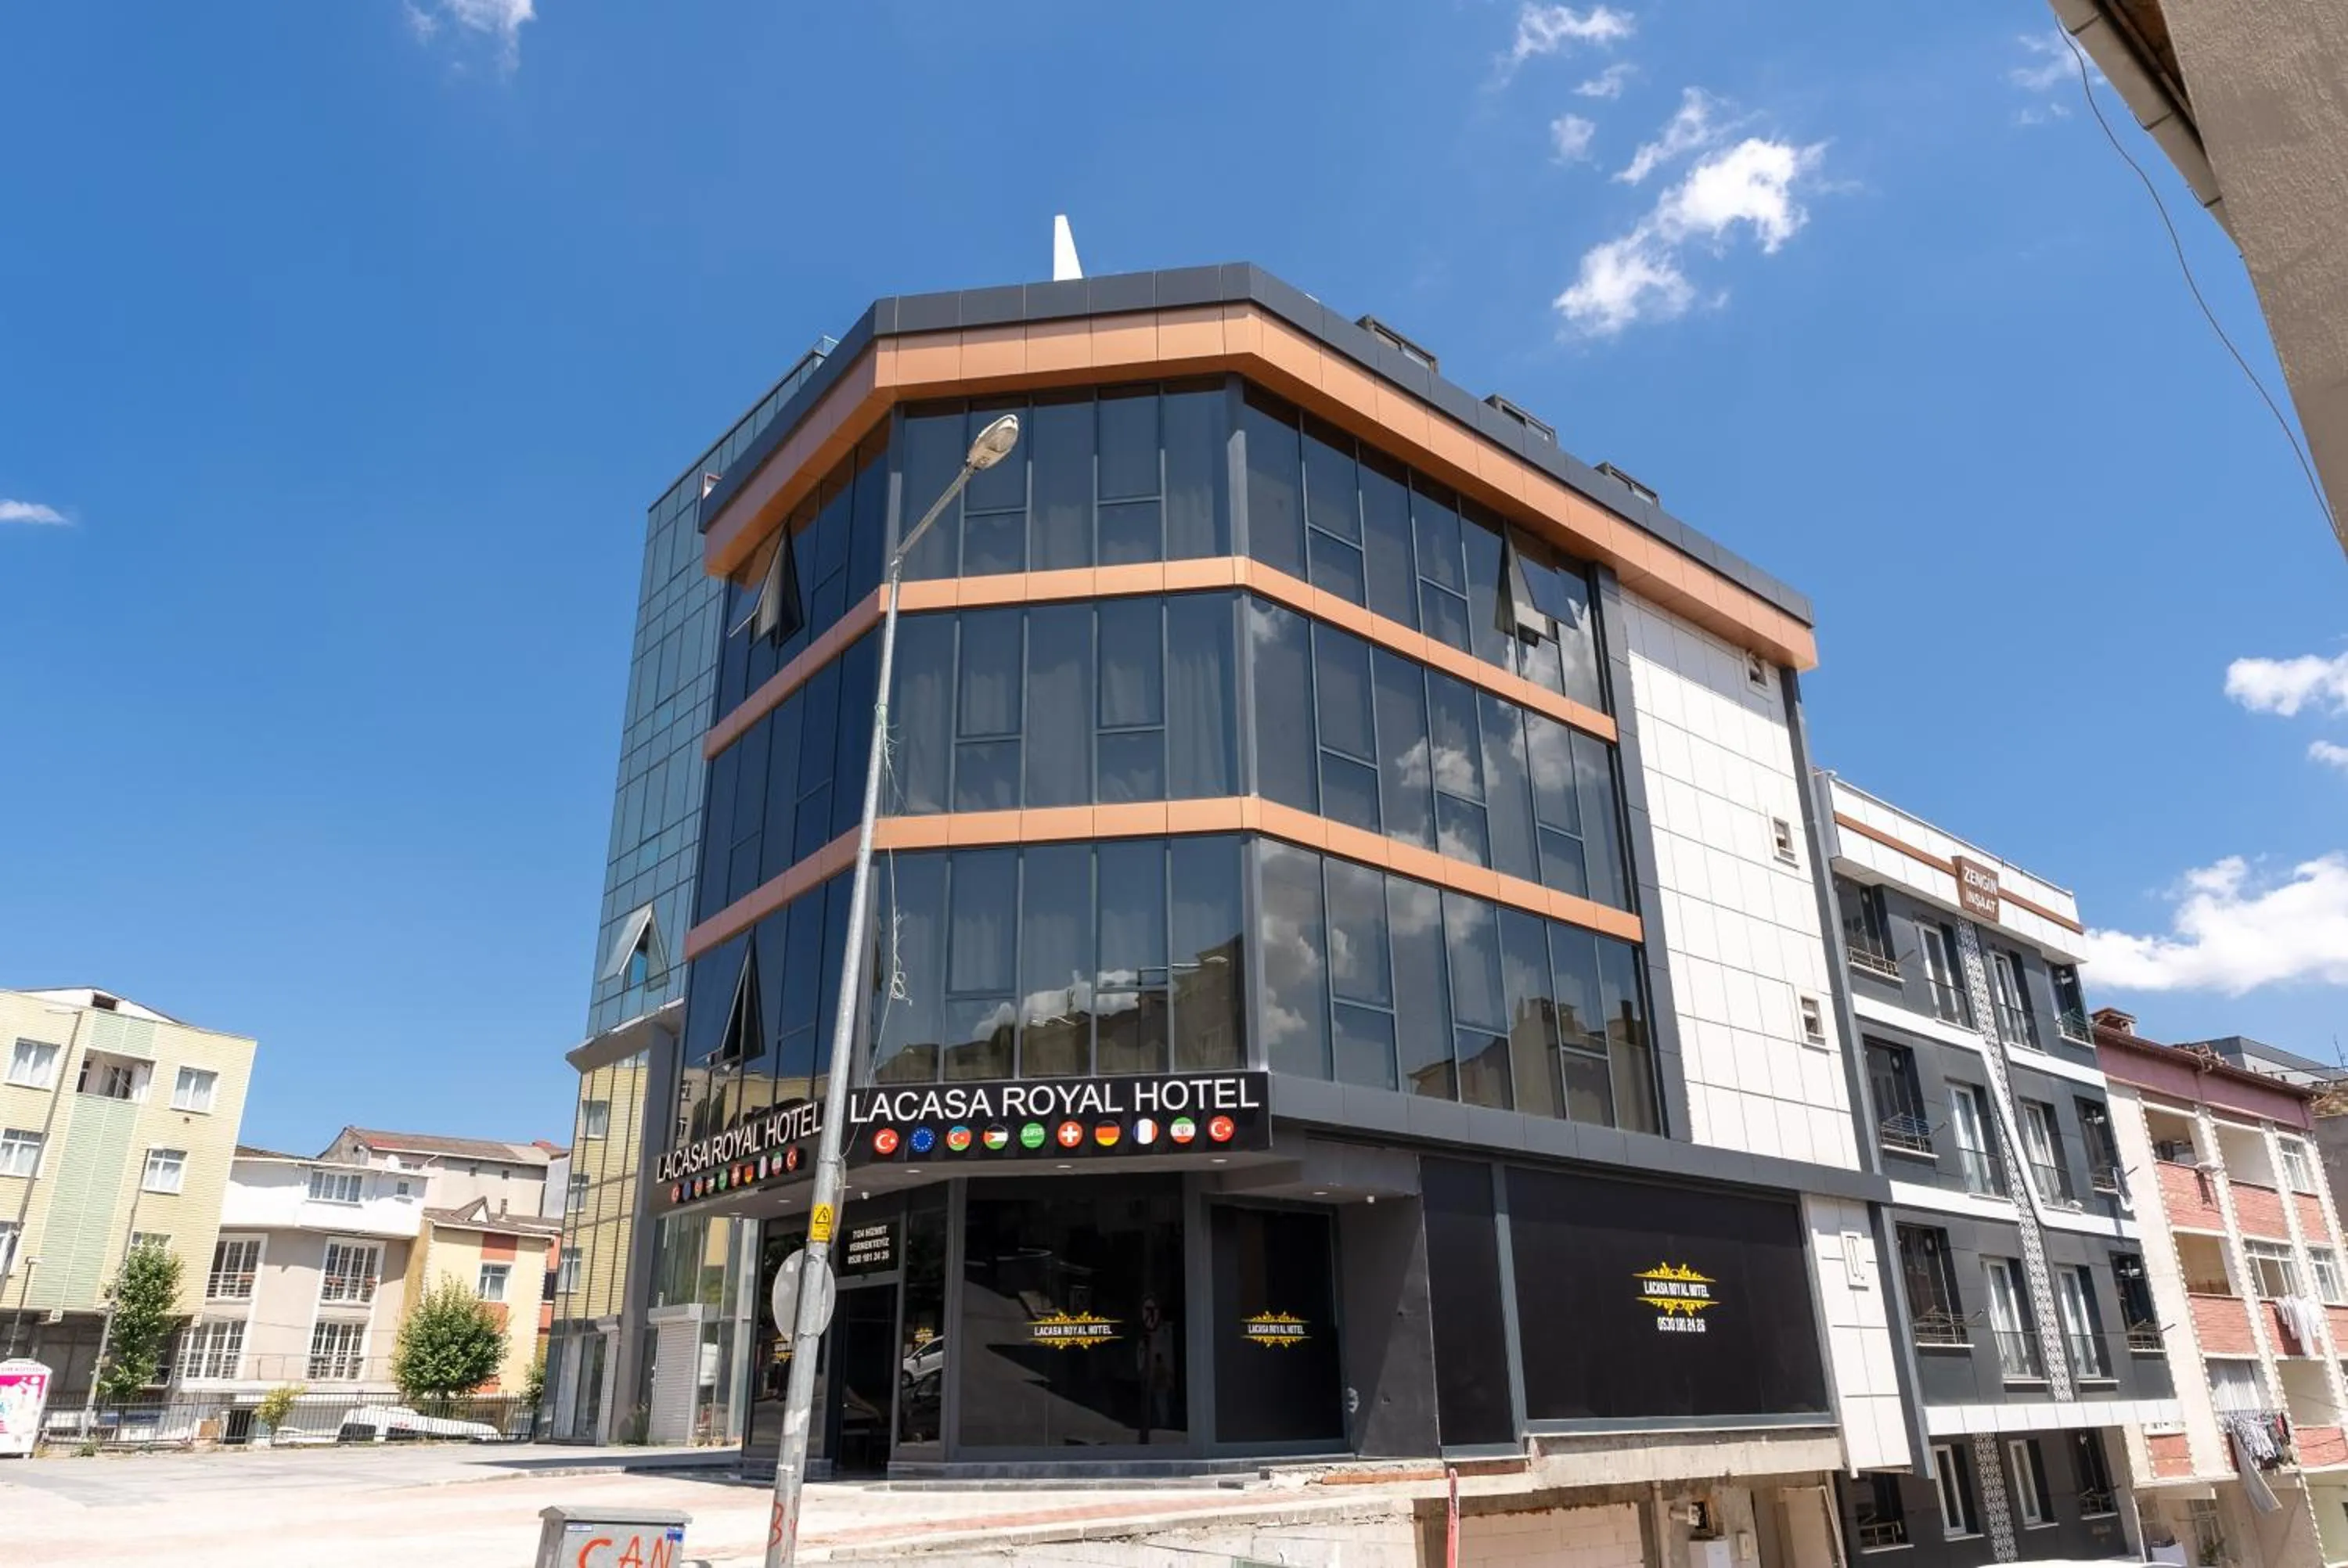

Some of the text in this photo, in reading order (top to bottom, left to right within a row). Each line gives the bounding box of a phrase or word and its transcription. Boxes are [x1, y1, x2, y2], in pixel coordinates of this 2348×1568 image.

[850, 1077, 1259, 1124] LACASA ROYAL HOTEL
[656, 1102, 823, 1184] LACASA ROYAL HOTEL
[1644, 1280, 1669, 1295] LACASA
[1034, 1325, 1112, 1336] LACASA ROYAL HOTEL
[1248, 1324, 1268, 1334] LACASA
